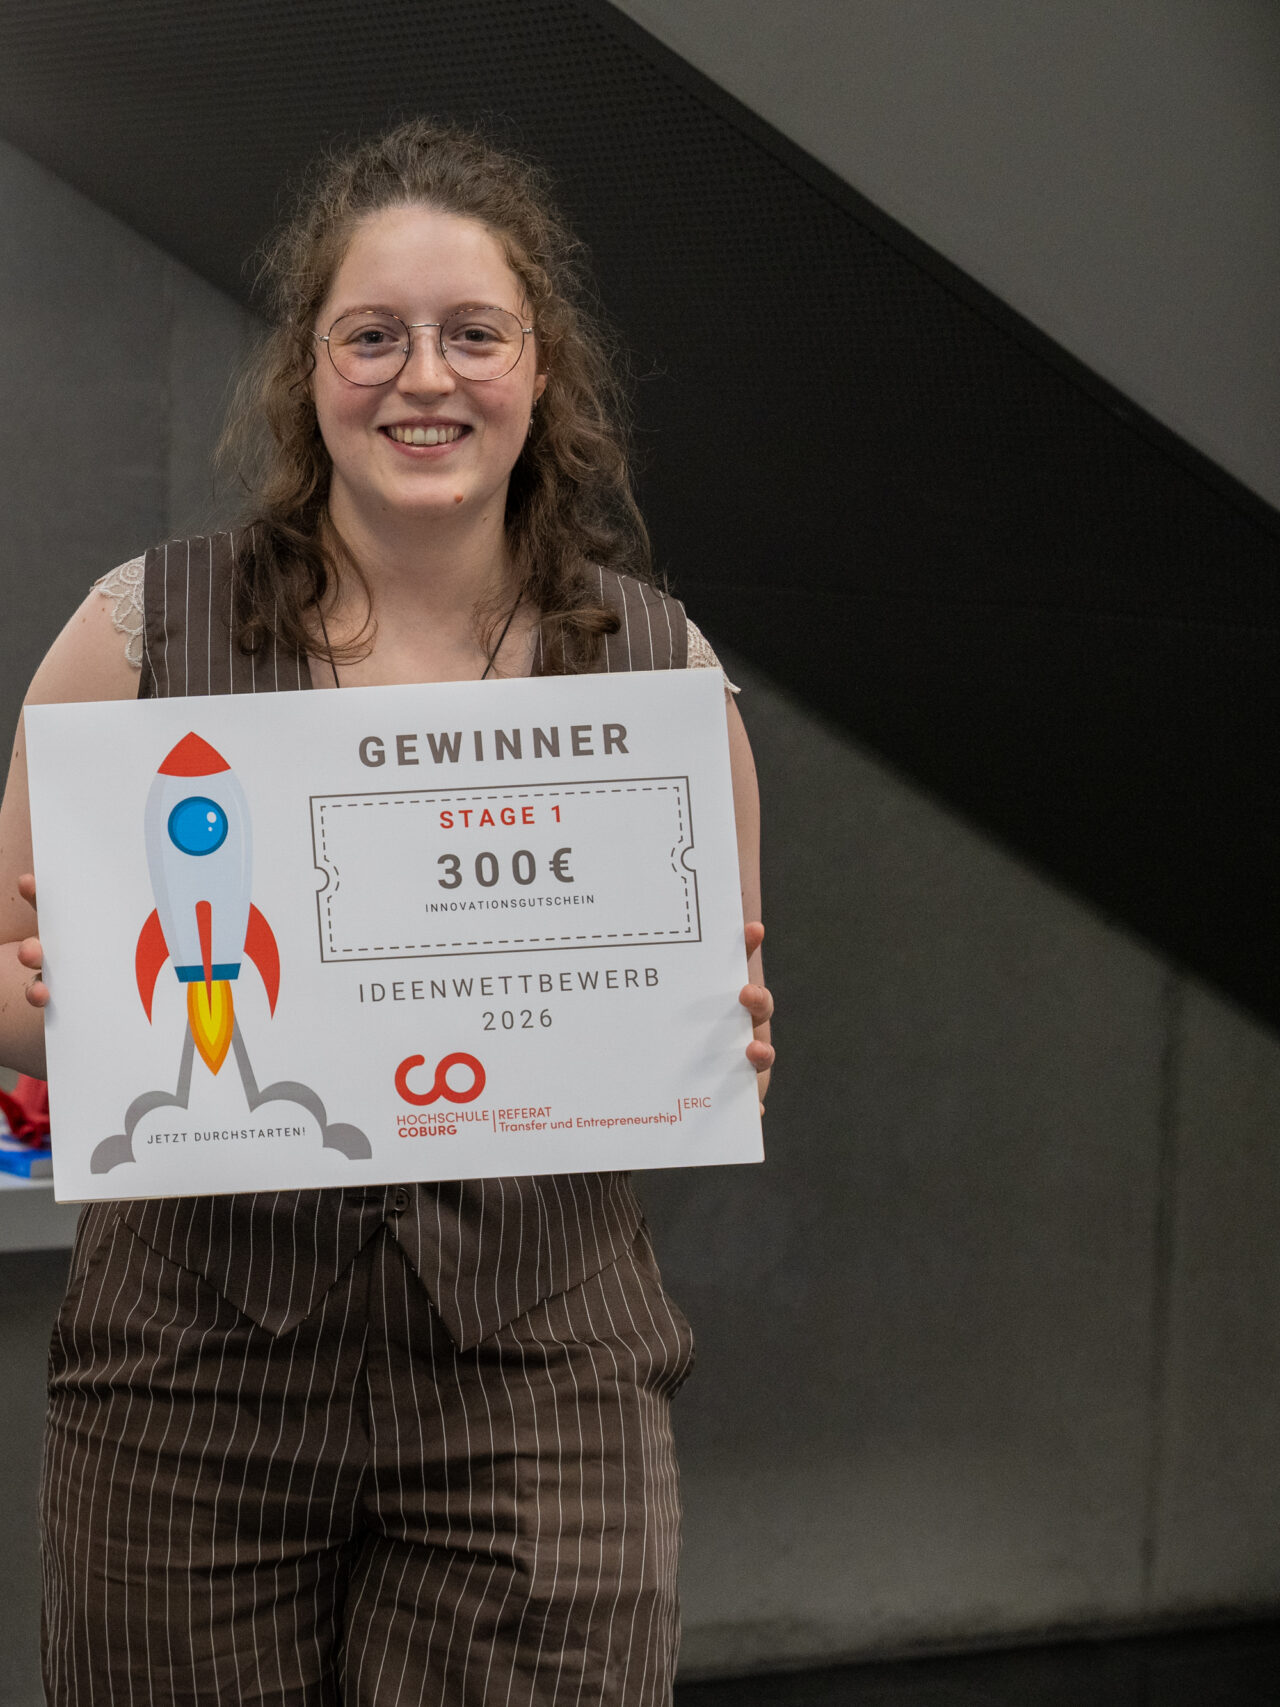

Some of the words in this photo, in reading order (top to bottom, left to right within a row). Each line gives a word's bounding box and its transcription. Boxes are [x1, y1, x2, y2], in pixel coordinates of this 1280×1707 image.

[358, 723, 630, 768] GEWINNER
[439, 806, 536, 829] STAGE
[551, 804, 561, 823] 1
[437, 847, 575, 890] 300€
[425, 894, 595, 913] INNOVATIONSGUTSCHEIN
[359, 967, 659, 1003] IDEENWETTBEWERB
[482, 1008, 553, 1031] 2026
[683, 1097, 712, 1109] ERIC
[396, 1110, 490, 1126] HOCHSCHULE
[498, 1106, 552, 1120] REFERAT
[499, 1119, 547, 1132] Transfer
[550, 1116, 573, 1129] und
[576, 1112, 677, 1128] Entrepreneurship
[147, 1133, 188, 1144] JETZT
[194, 1127, 306, 1142] DURCHSTARTEN!
[398, 1125, 458, 1138] COBURG
